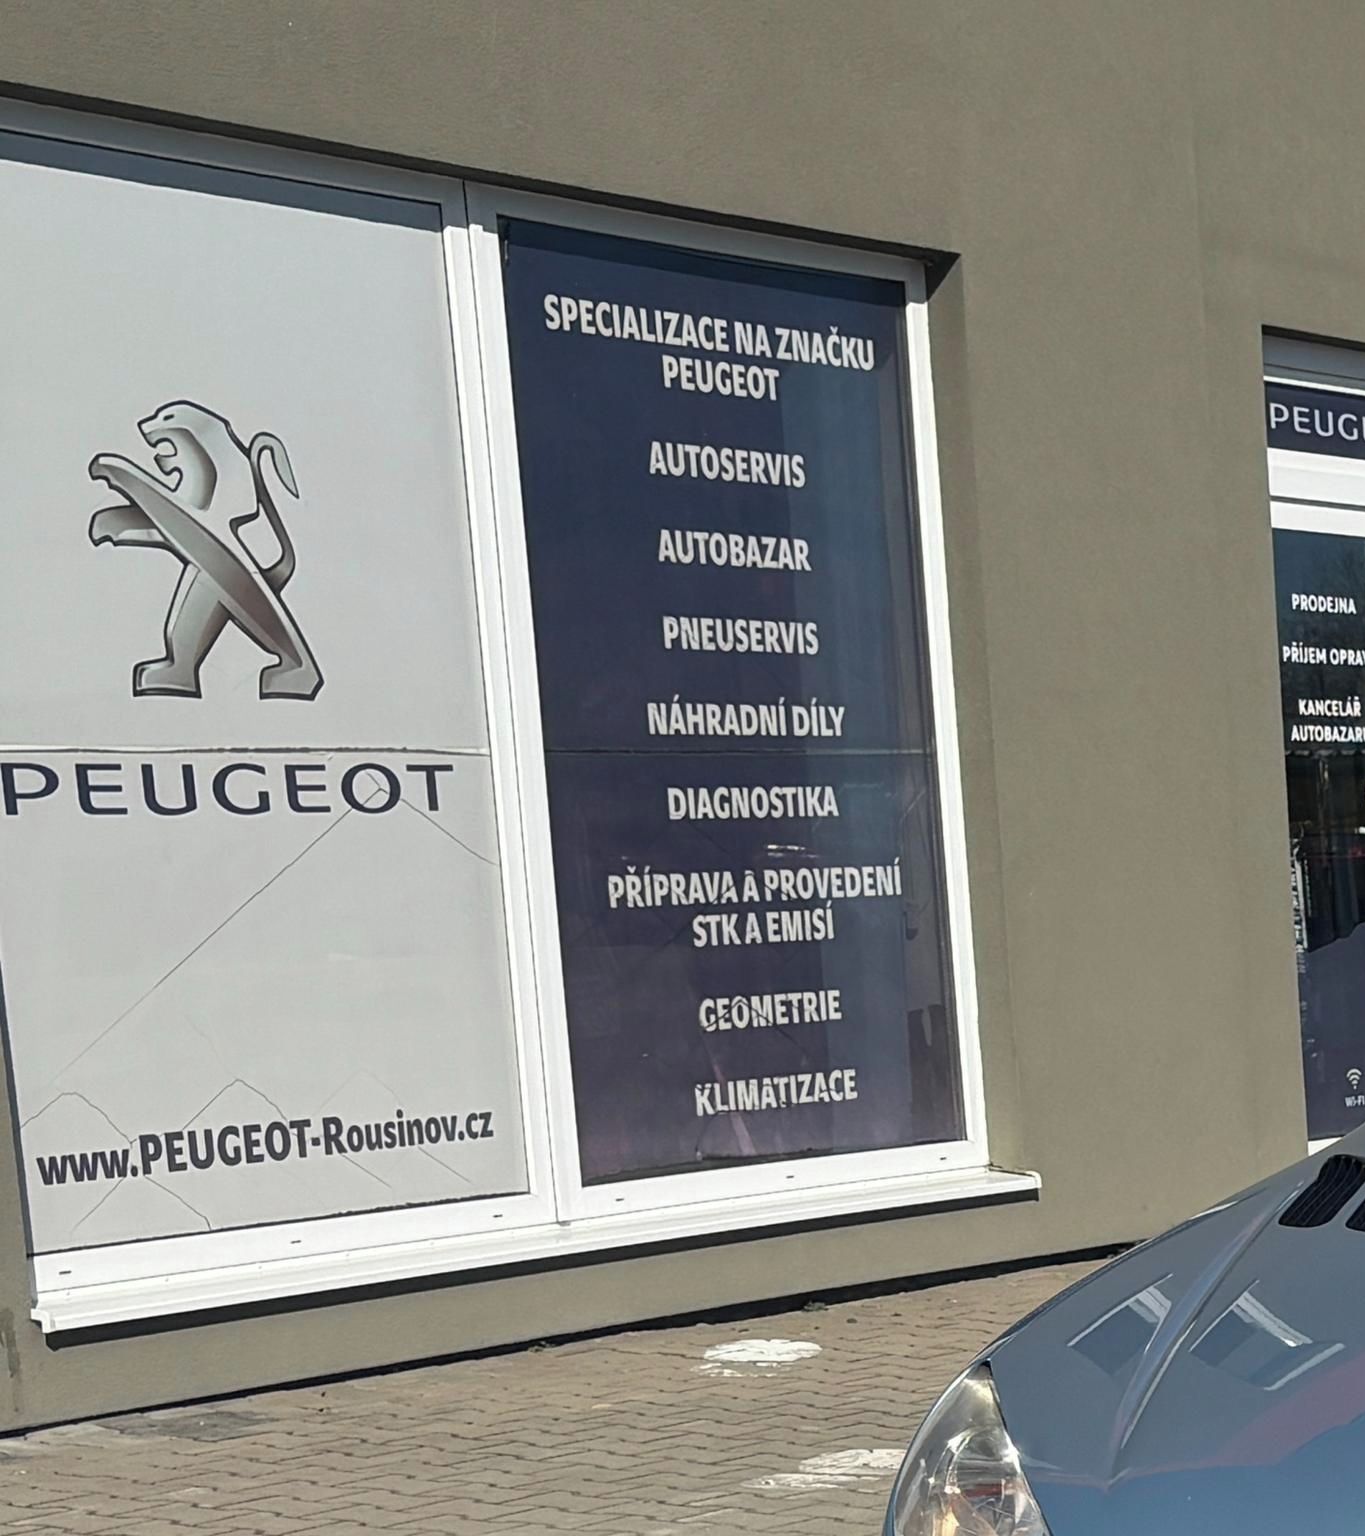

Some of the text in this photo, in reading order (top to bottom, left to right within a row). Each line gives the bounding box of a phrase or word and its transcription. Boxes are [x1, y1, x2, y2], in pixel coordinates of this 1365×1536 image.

[544, 293, 875, 371] SPECIALIZACE NA ZNAČKU
[662, 354, 779, 400] PEUGEOT
[649, 441, 806, 488] AUTOSERVIS
[658, 529, 811, 571] AUTOBAZAR
[1291, 593, 1357, 614] PRODEJNA
[663, 616, 818, 655] PNEUSERVIS
[1282, 642, 1327, 665] PŘÍJEM
[647, 694, 845, 737] NÁHRADNÍ DÍLY
[1298, 696, 1361, 717] KANCELÁŘ
[0, 762, 454, 816] PEUGEOT
[668, 786, 839, 820] DIAGNOSTIKA
[608, 857, 902, 908] PŘÍPRAVA A PROVEDENÍ
[693, 901, 835, 948] STK A EMISÍ
[699, 989, 842, 1032] GEOMETRIE
[695, 1068, 858, 1117] KLIMATIZACE
[36, 1109, 494, 1186] www.PEUGEOT-Rousinov.cz
